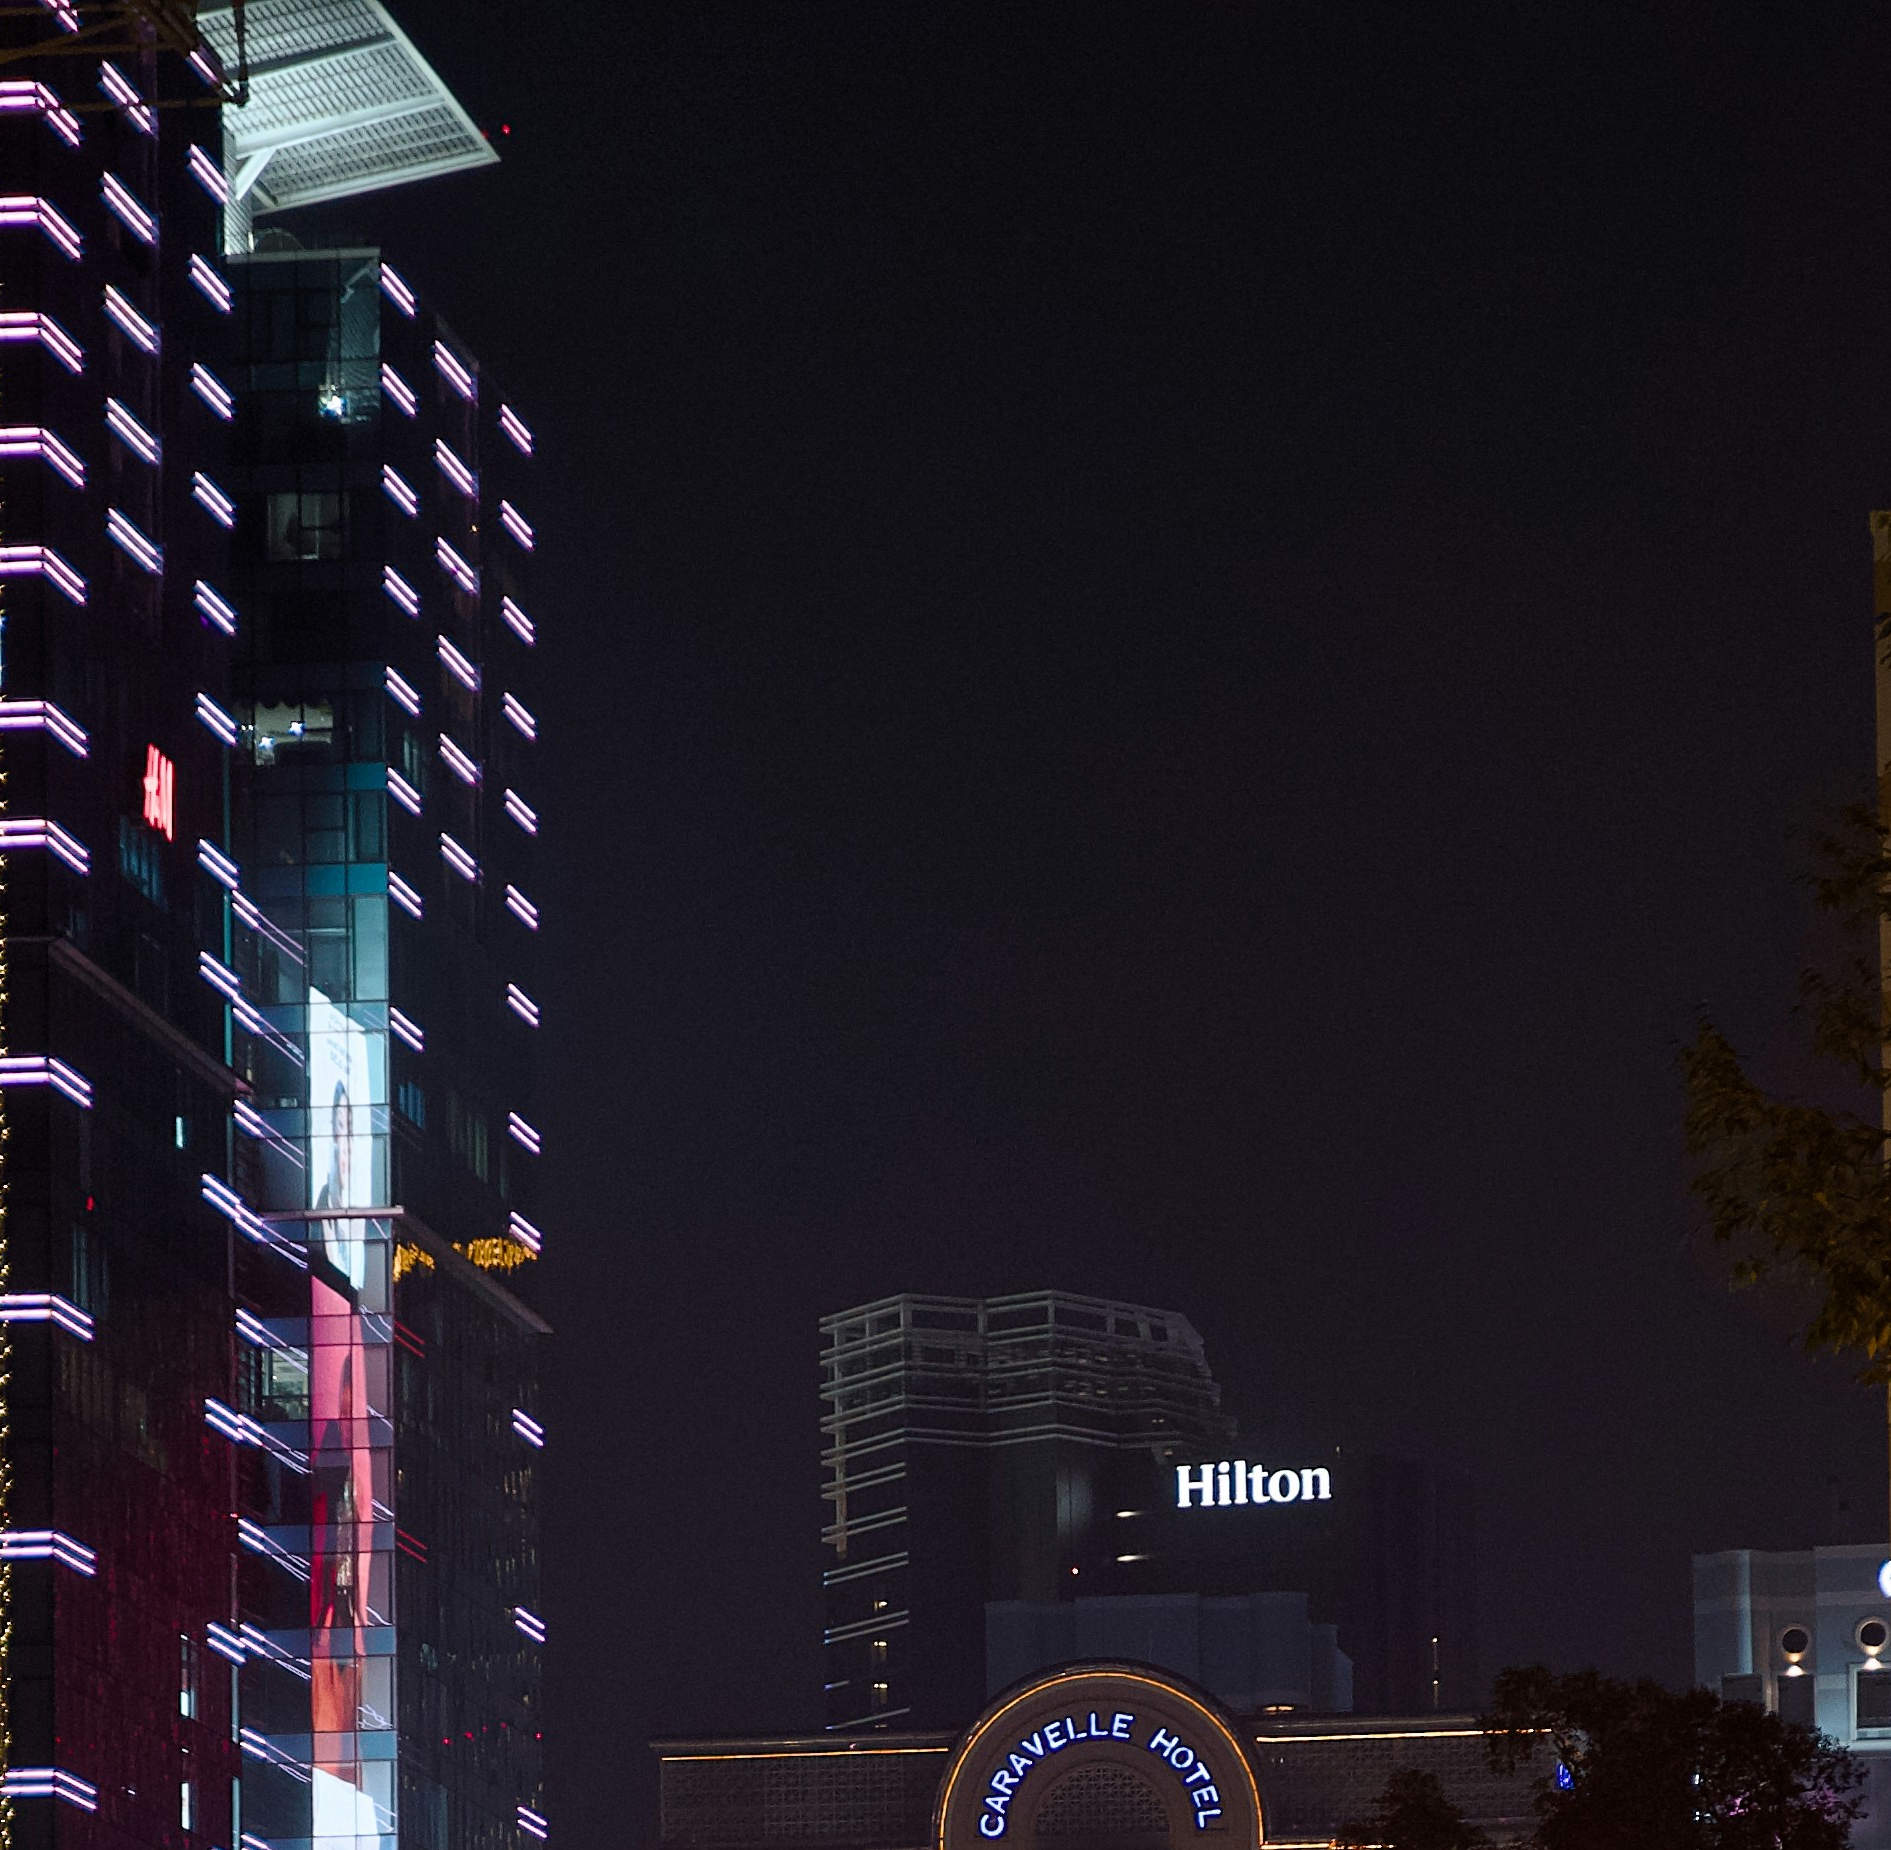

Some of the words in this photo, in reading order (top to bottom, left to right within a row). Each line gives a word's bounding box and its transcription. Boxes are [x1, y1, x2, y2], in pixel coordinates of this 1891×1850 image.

[1176, 1460, 1332, 1508] Hilton
[980, 1712, 1134, 1837] CARAVELLE
[1150, 1728, 1222, 1828] HOTEL
